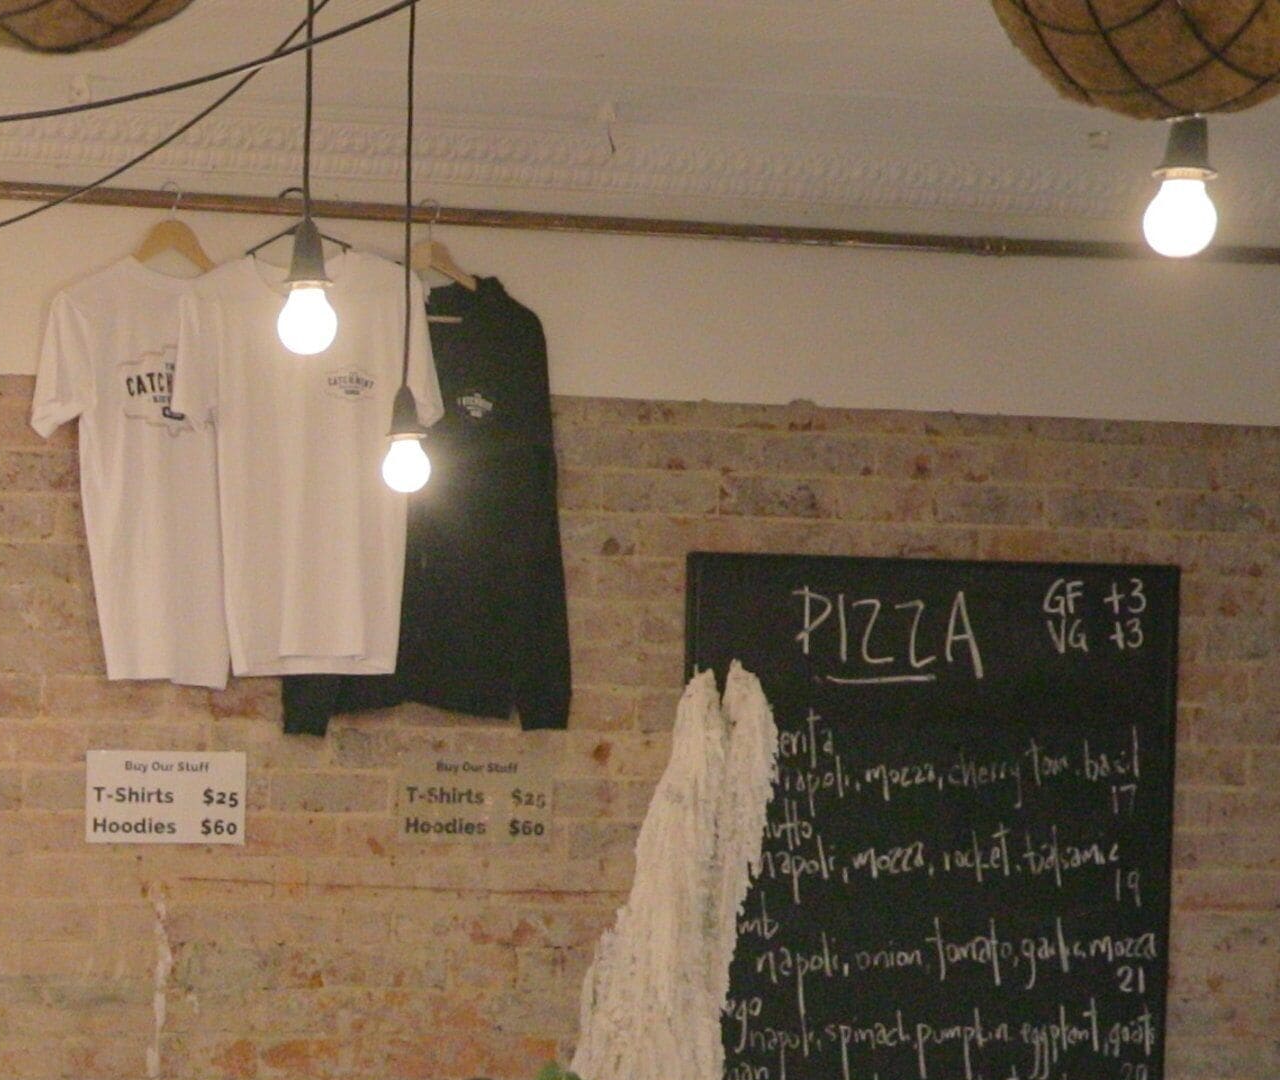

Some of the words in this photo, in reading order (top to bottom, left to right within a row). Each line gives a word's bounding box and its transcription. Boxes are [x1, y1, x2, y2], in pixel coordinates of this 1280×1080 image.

[1044, 578, 1085, 615] GF
[1104, 578, 1147, 614] +3
[791, 585, 984, 679] PIZZA
[1047, 618, 1089, 654] VG
[124, 760, 148, 773] Buy
[151, 761, 174, 772] Our
[177, 761, 210, 773] Stuff
[436, 760, 459, 774] Buy
[462, 761, 484, 773] Our
[487, 761, 519, 774] Stuff
[93, 786, 174, 804] T-Shirts
[203, 788, 239, 808] $25
[406, 786, 485, 804] T-Shirts
[511, 788, 547, 809] $25
[1112, 783, 1137, 815] 17
[93, 817, 177, 835] Hoodies
[201, 817, 238, 836] $60
[405, 816, 487, 835] Hoodies
[509, 817, 545, 837] $60
[1116, 965, 1145, 994] 21
